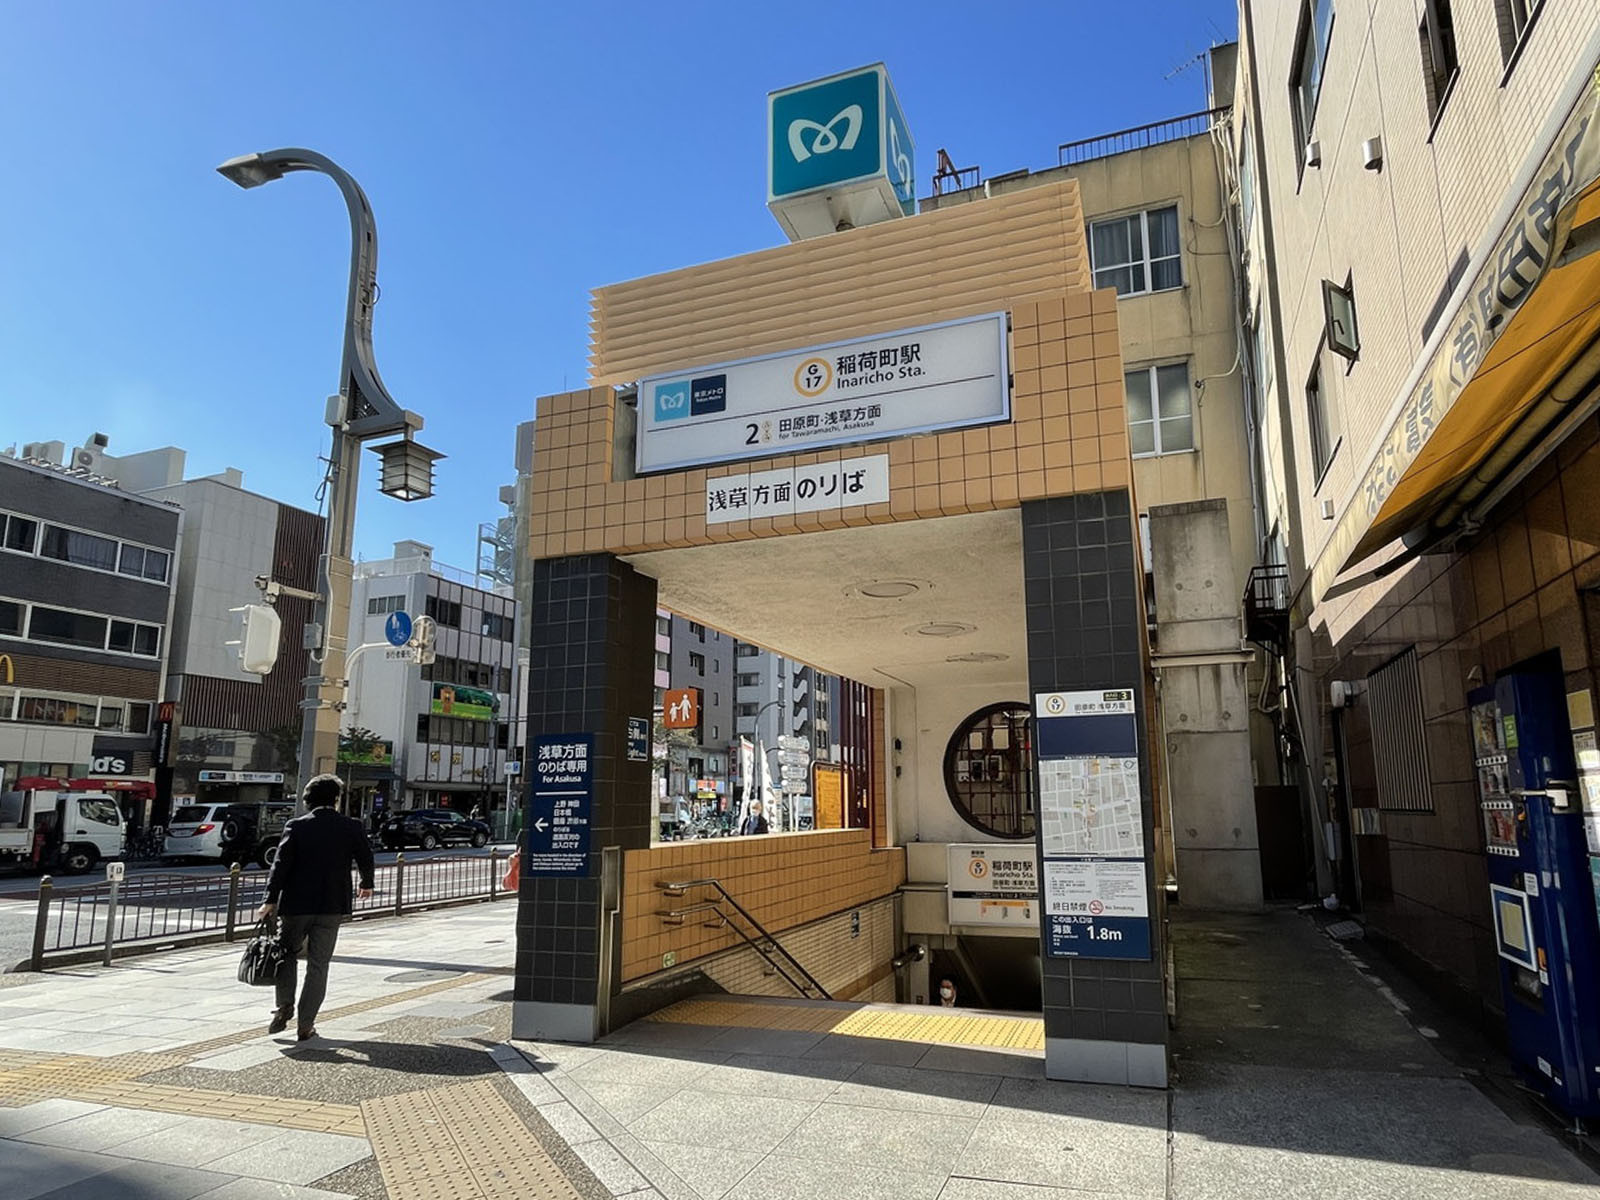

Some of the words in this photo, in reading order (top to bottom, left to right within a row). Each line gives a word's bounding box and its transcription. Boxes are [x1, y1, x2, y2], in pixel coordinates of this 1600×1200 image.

[836, 343, 921, 375] 稲荷町駅
[807, 364, 818, 375] G
[805, 375, 822, 388] 17
[837, 371, 894, 389] Inaricho
[898, 366, 926, 379] Sta.
[745, 422, 759, 446] 2
[779, 432, 789, 440] for
[792, 425, 841, 438] Tawaramachi,
[843, 420, 875, 431] Asakusa
[1121, 691, 1128, 700] 3
[538, 743, 588, 760] 浅草方面
[538, 760, 588, 773] のりば専用
[542, 775, 553, 783] For
[554, 774, 582, 783] Asakusa
[554, 800, 567, 808] 上野
[552, 841, 579, 849] 出入口です
[992, 861, 1033, 871] 稲荷町駅
[1053, 902, 1087, 911] 終日禁煙
[1052, 915, 1093, 924] この出入口は
[1087, 925, 1122, 941] 1.8m
